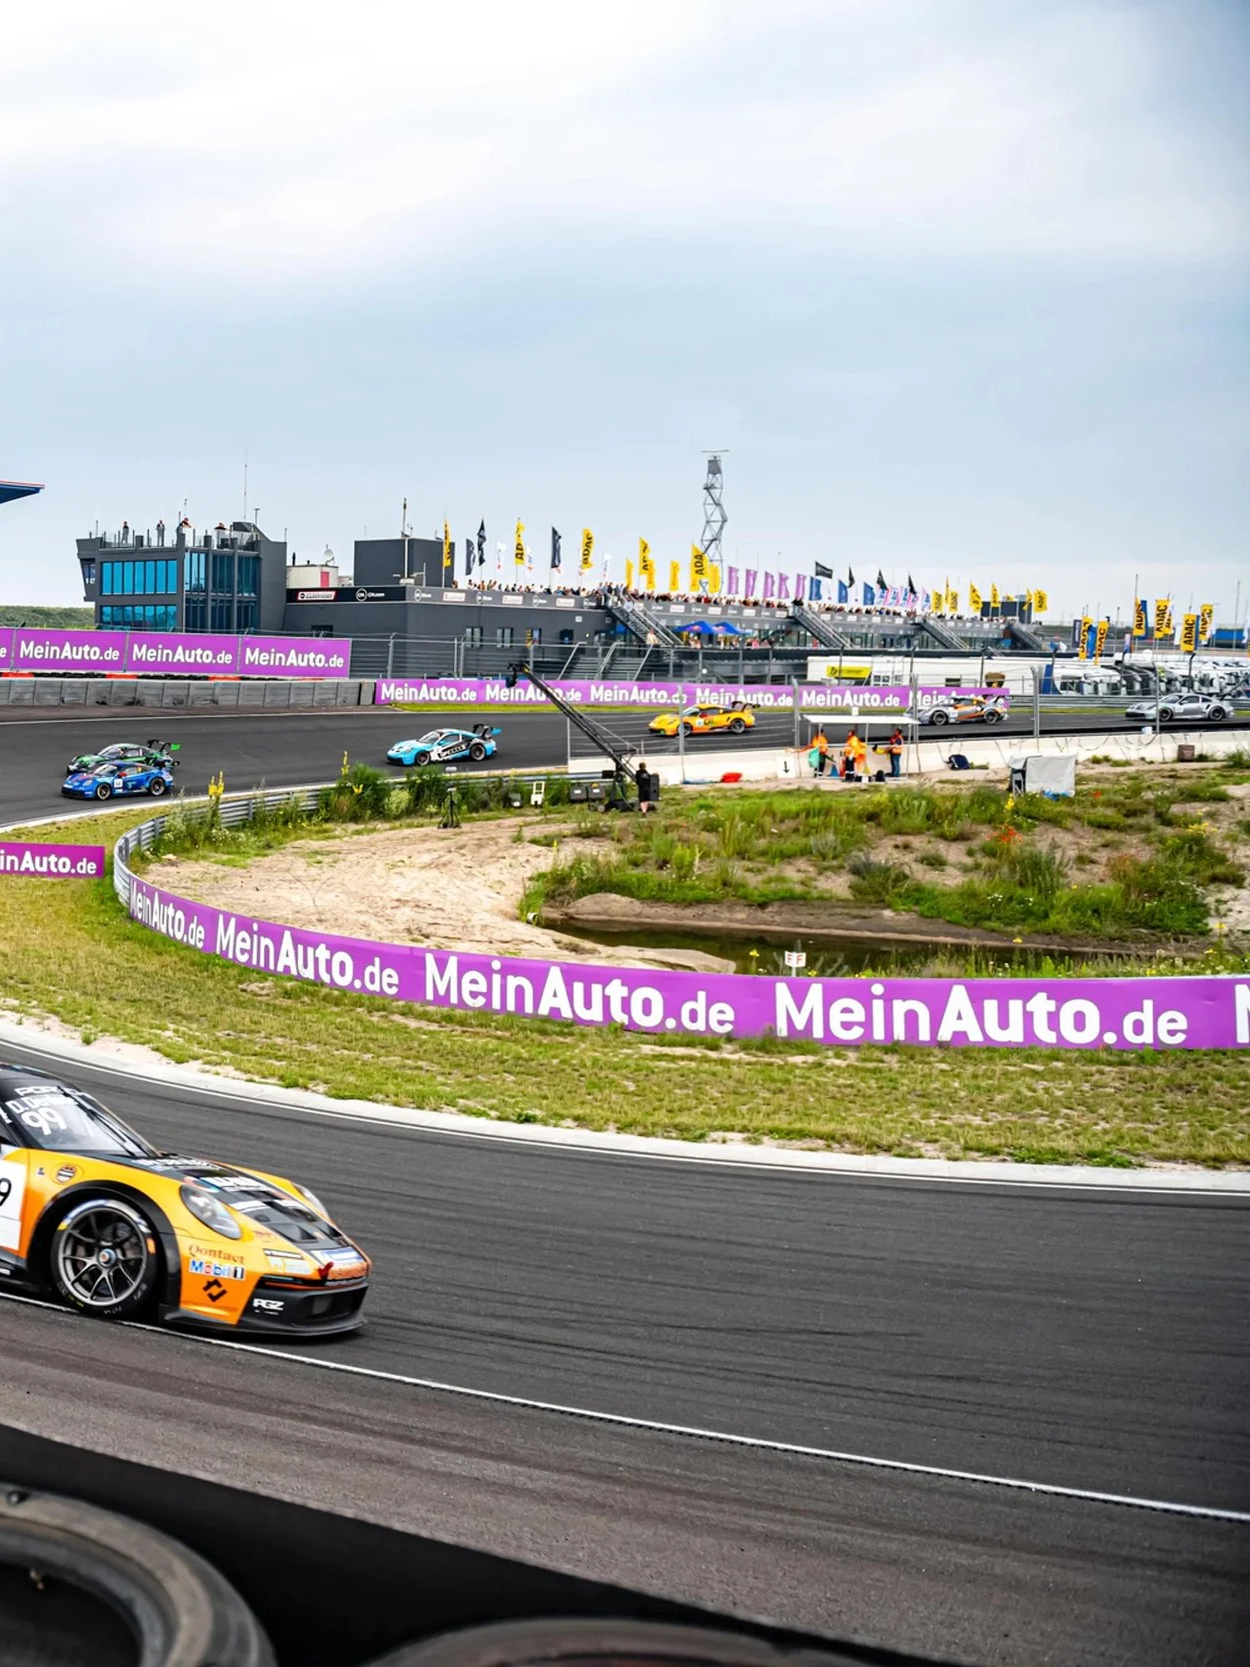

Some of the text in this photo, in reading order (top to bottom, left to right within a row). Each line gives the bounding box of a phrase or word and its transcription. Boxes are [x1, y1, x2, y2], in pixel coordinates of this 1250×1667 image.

[1155, 604, 1168, 633] ADAC
[1183, 618, 1196, 647] ADAC
[20, 640, 120, 661] MeinAuto.de
[132, 643, 233, 665] MeinAuto.de
[245, 647, 344, 668] MeinAuto.de
[381, 682, 477, 702] MeinAuto.de
[696, 687, 793, 706] MeinAuto.de
[802, 689, 899, 707] MeinAuto.de
[129, 881, 205, 949] MeinAuto.de
[216, 913, 399, 996] MeinAuto.de
[425, 952, 736, 1034] MeinAuto.de
[775, 982, 1188, 1046] MeinAuto.de
[21, 1107, 68, 1136] 99
[188, 1243, 245, 1264] Qontact
[190, 1259, 232, 1277] Mobil
